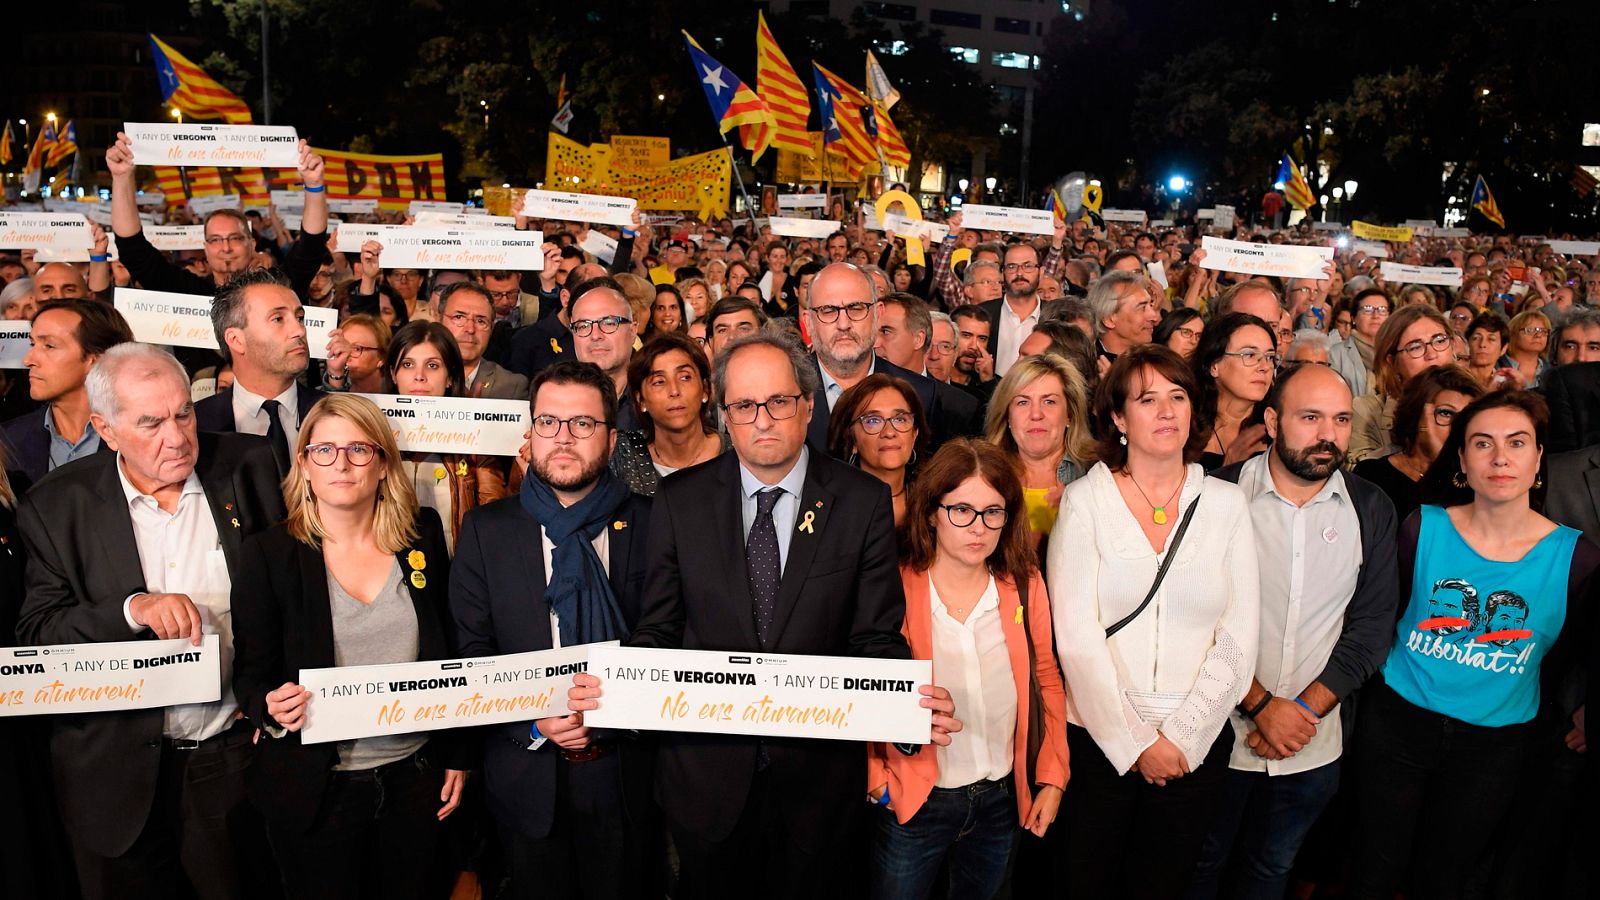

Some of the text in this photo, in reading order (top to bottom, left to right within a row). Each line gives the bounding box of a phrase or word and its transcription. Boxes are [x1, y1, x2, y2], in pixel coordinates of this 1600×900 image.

[172, 134, 217, 142] VERGONYA
[134, 302, 155, 314] ANY
[156, 304, 170, 314] DE
[434, 410, 456, 420] ANY
[458, 412, 471, 421] DE
[474, 412, 522, 423] DIGNITAT
[62, 662, 68, 672] 1
[74, 660, 105, 672] ANY
[109, 659, 129, 671] DE
[133, 652, 202, 670] DIGNITAT
[1406, 630, 1535, 674] llibertat!!
[33, 678, 145, 705] aturarem!
[320, 661, 588, 699] 1 ANY DE VERGONYA 1 ANY DE DIGNIT
[604, 667, 915, 693] 1 ANY DE VERGONYA 1 ANY DE DIGNITAT
[377, 687, 555, 726] No ens aturarem!
[661, 691, 853, 729] No ens aturarem!
